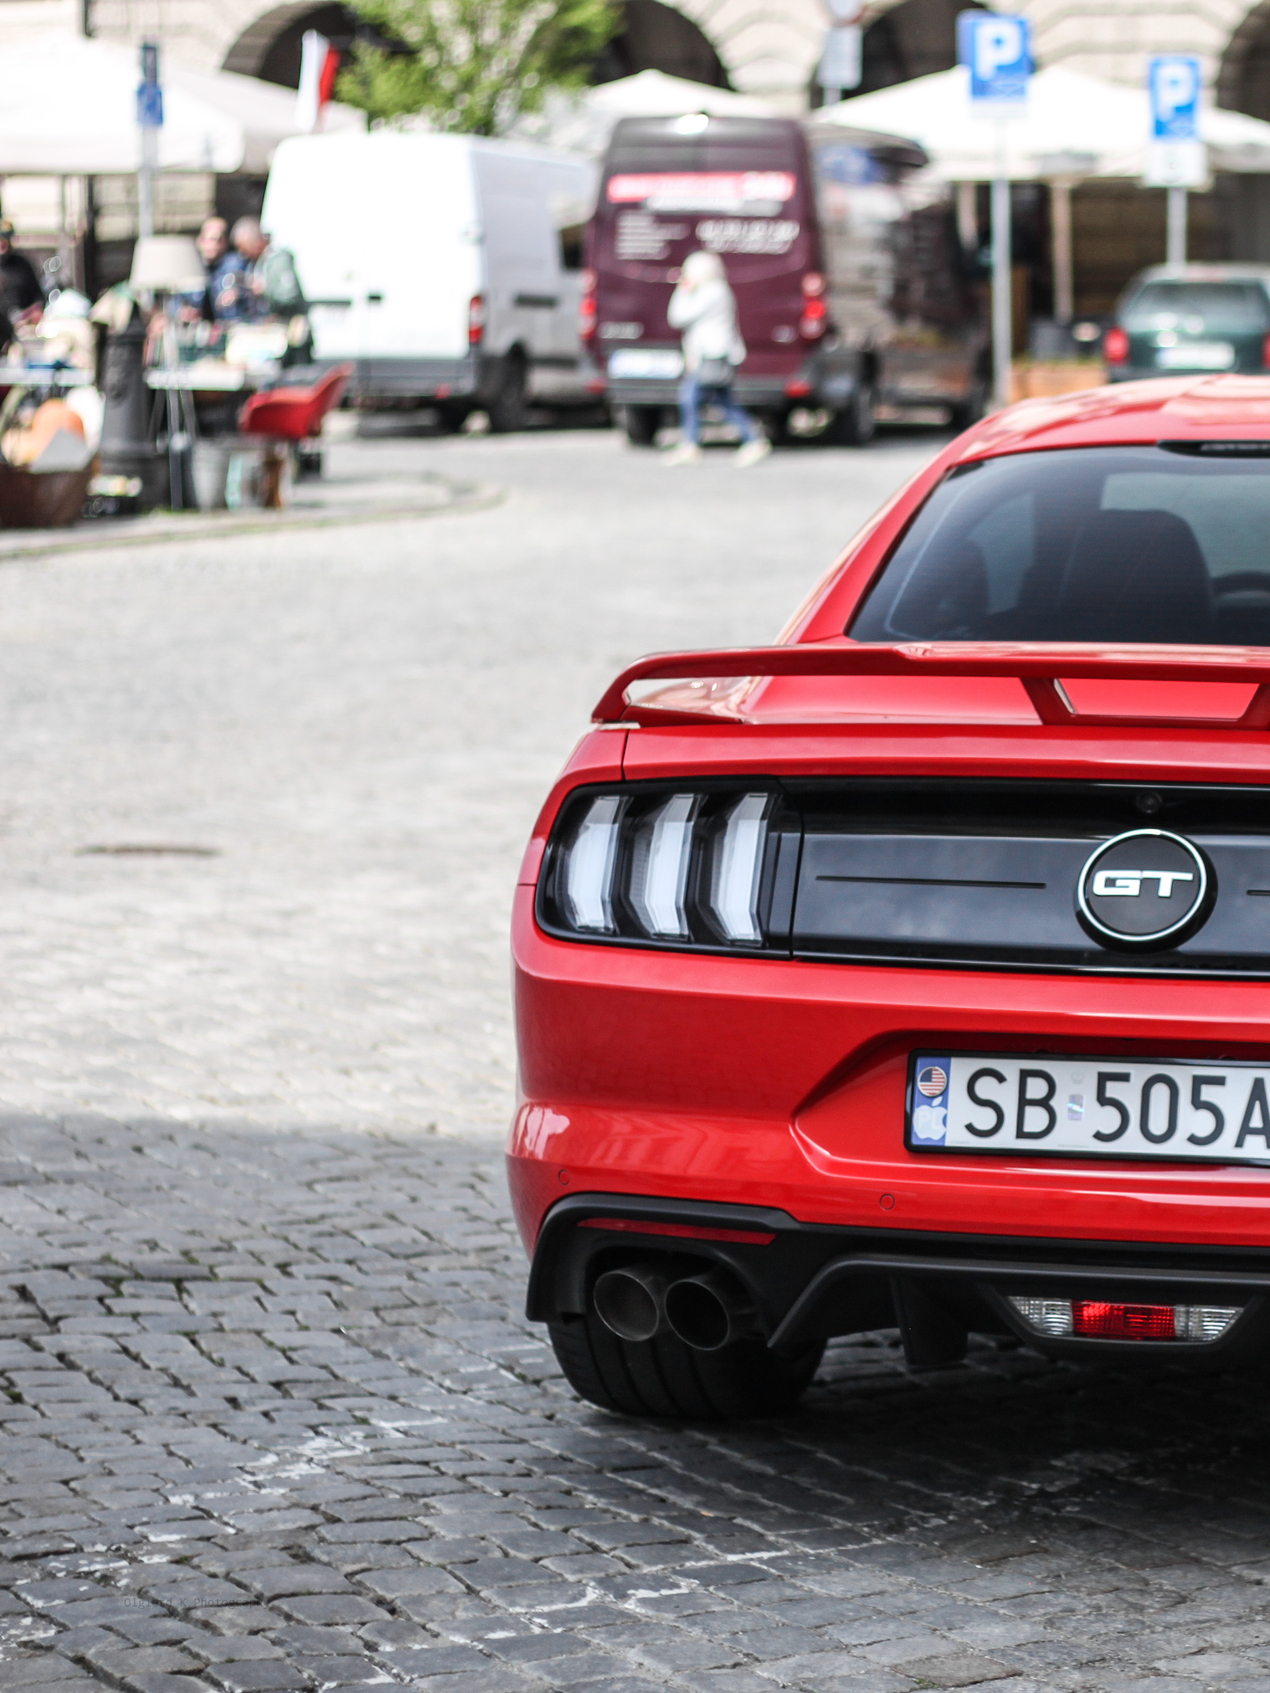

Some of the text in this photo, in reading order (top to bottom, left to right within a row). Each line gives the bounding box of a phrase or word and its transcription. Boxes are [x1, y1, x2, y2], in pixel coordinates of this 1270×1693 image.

[974, 20, 1023, 81] P
[1157, 64, 1196, 122] P
[1092, 870, 1193, 898] GT
[964, 1067, 1058, 1140] SB
